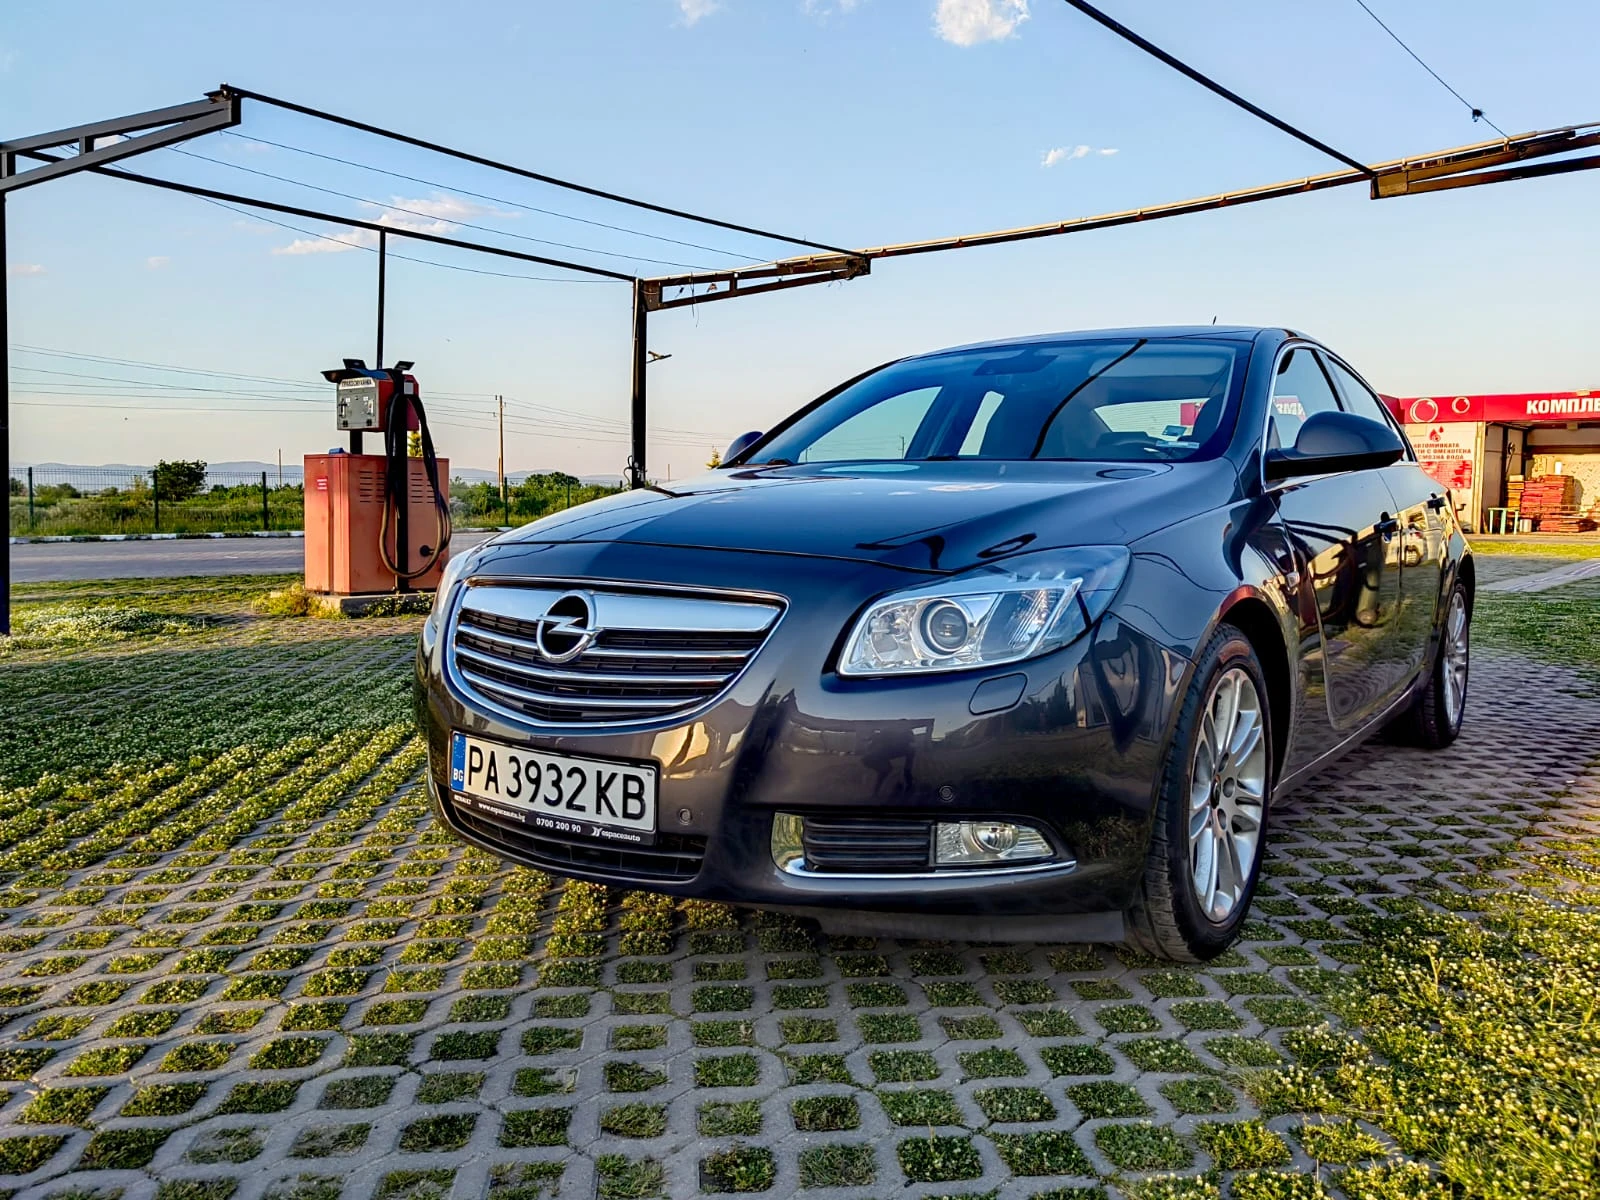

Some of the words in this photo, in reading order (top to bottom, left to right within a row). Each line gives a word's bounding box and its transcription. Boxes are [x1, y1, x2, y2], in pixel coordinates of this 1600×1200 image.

[1526, 398, 1600, 414] КОМПЛЕ
[453, 768, 464, 782] BG
[536, 817, 554, 828] 0700
[555, 820, 570, 831] 200
[571, 823, 582, 833] 90
[601, 829, 641, 842] espaceauto
